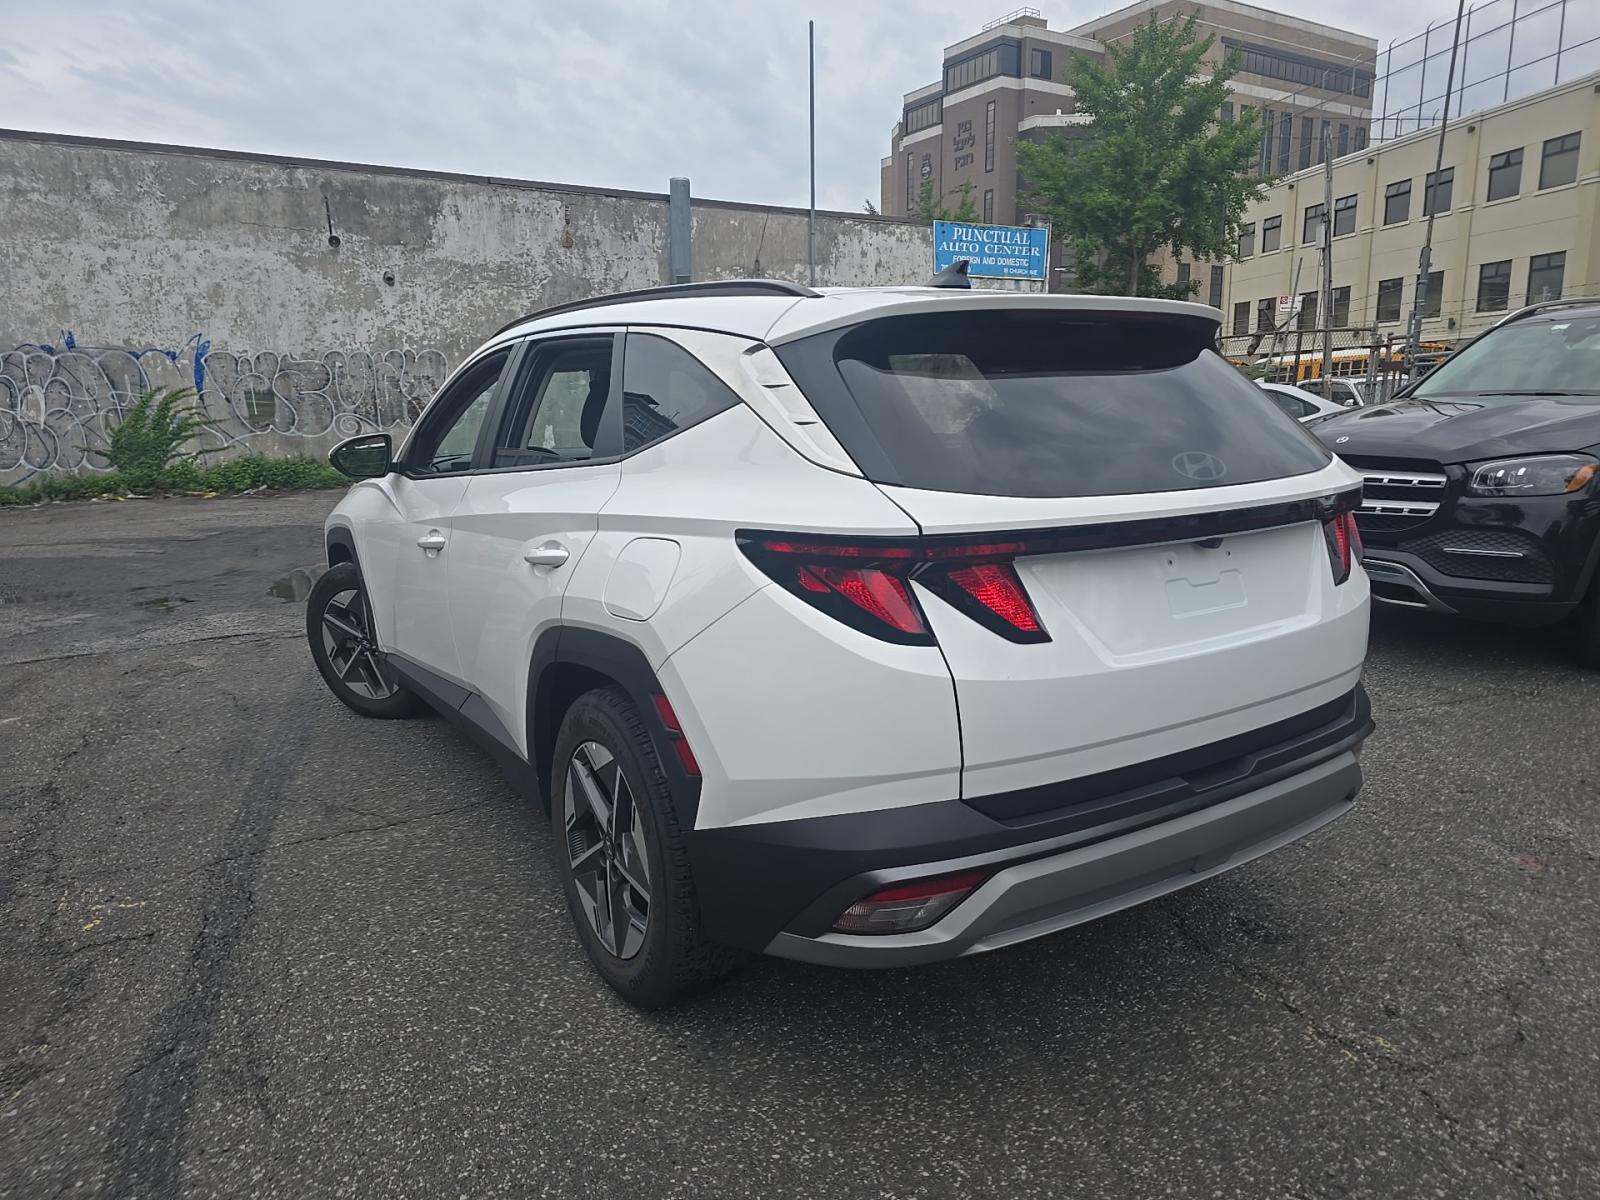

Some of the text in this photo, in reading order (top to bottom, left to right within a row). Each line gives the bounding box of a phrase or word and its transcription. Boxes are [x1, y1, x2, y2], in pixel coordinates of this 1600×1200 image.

[953, 228, 1030, 244] PUNCTUAL
[939, 241, 1040, 256] AUTO CENTER
[997, 257, 1029, 266] DOMESTIC
